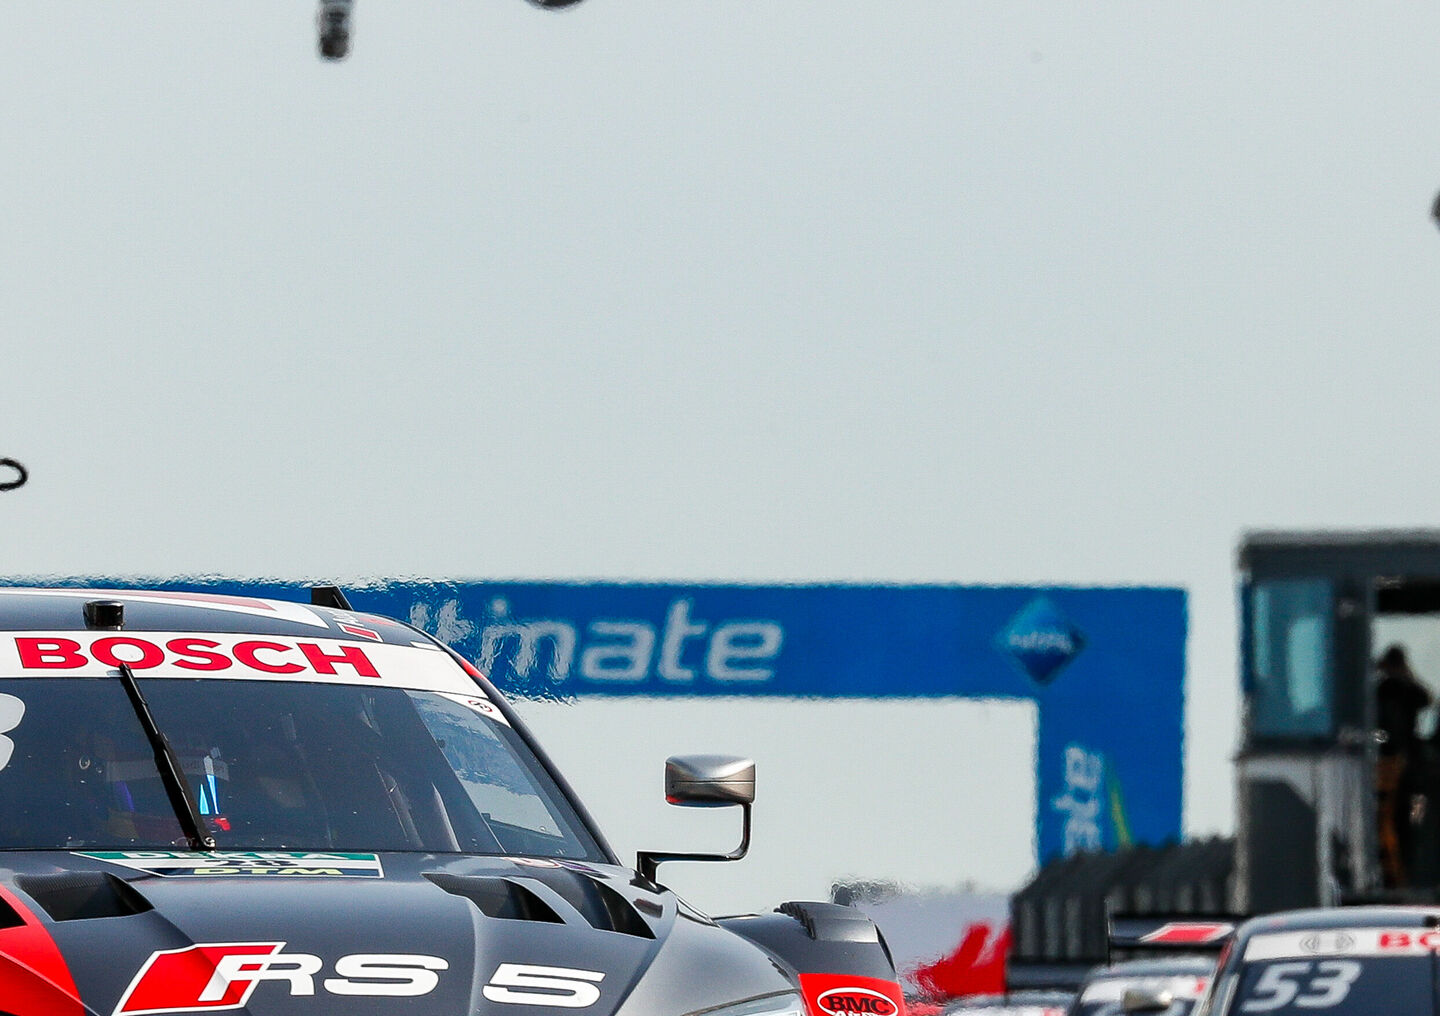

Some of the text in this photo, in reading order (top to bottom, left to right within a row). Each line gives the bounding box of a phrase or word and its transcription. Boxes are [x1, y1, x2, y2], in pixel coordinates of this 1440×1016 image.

[13, 636, 383, 679] BOSCH
[190, 867, 345, 876] DTM
[197, 952, 607, 1009] RS 5
[1241, 958, 1363, 1013] 53
[823, 994, 890, 1014] BMC
